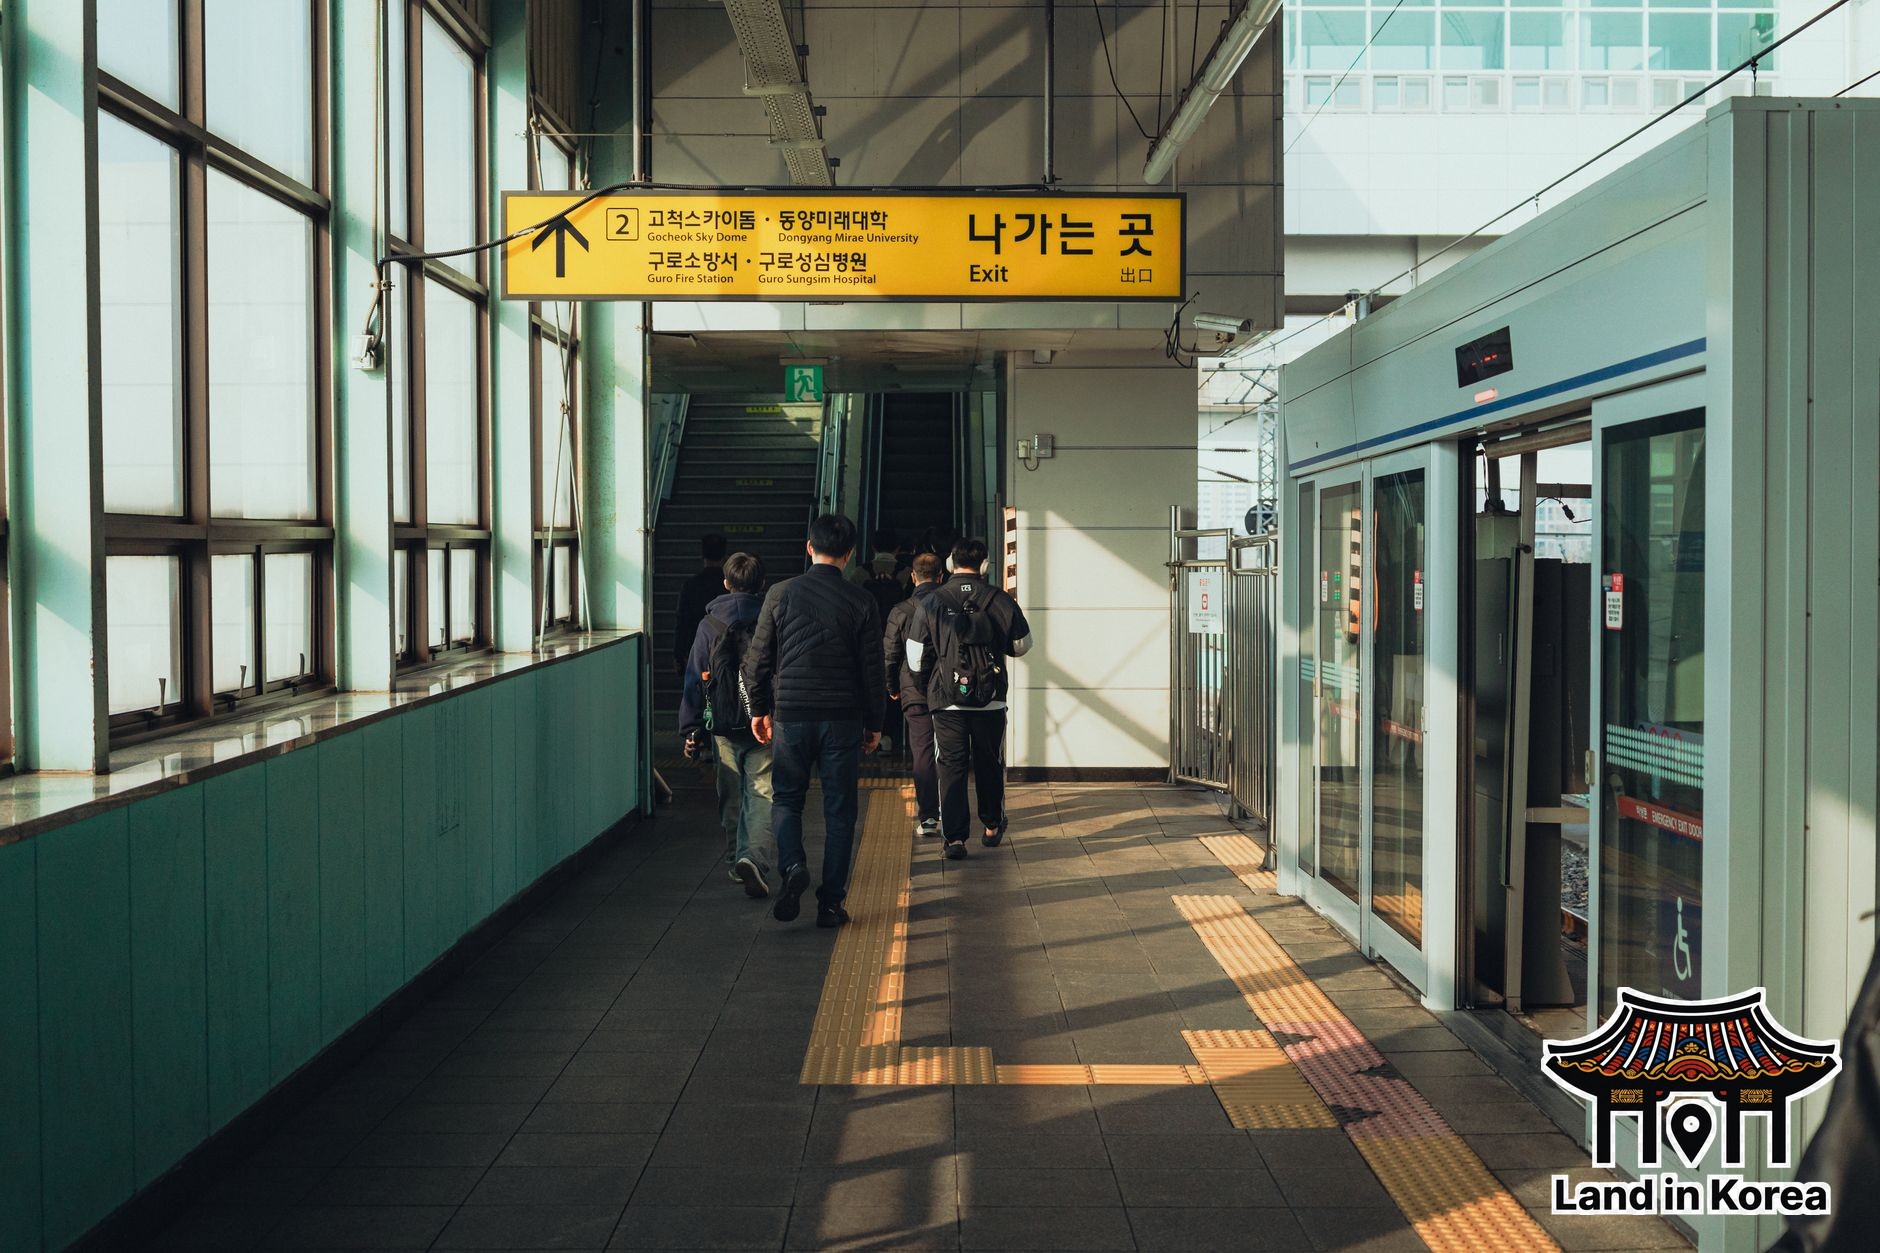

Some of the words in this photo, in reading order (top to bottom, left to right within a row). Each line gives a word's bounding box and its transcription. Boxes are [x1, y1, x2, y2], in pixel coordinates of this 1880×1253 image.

[615, 213, 630, 235] 2
[648, 209, 756, 231] 고척스카이돔
[778, 209, 889, 232] 동양미래대학
[647, 231, 694, 242] Gocheok
[695, 232, 714, 244] Sky
[716, 232, 748, 242] Dome
[778, 232, 833, 245] Dongyang
[834, 231, 865, 242] Mirae
[866, 232, 920, 245] University
[968, 212, 1095, 256] 나가는
[1118, 213, 1154, 257] 곳
[648, 251, 738, 273] 구로소방서
[758, 251, 867, 273] 구로성심병원
[647, 273, 673, 283] Guro
[675, 273, 695, 283] Fire
[696, 273, 734, 283] Station
[758, 273, 784, 283] Guro
[786, 273, 831, 286] Sungsim
[833, 273, 877, 286] Hospital
[969, 264, 1009, 283] Exit
[1120, 266, 1153, 284] 出口
[739, 681, 750, 703] NORTH
[1651, 811, 1678, 830] EMERGENCY
[1678, 820, 1688, 835] EXIT
[1688, 823, 1703, 839] DOOR
